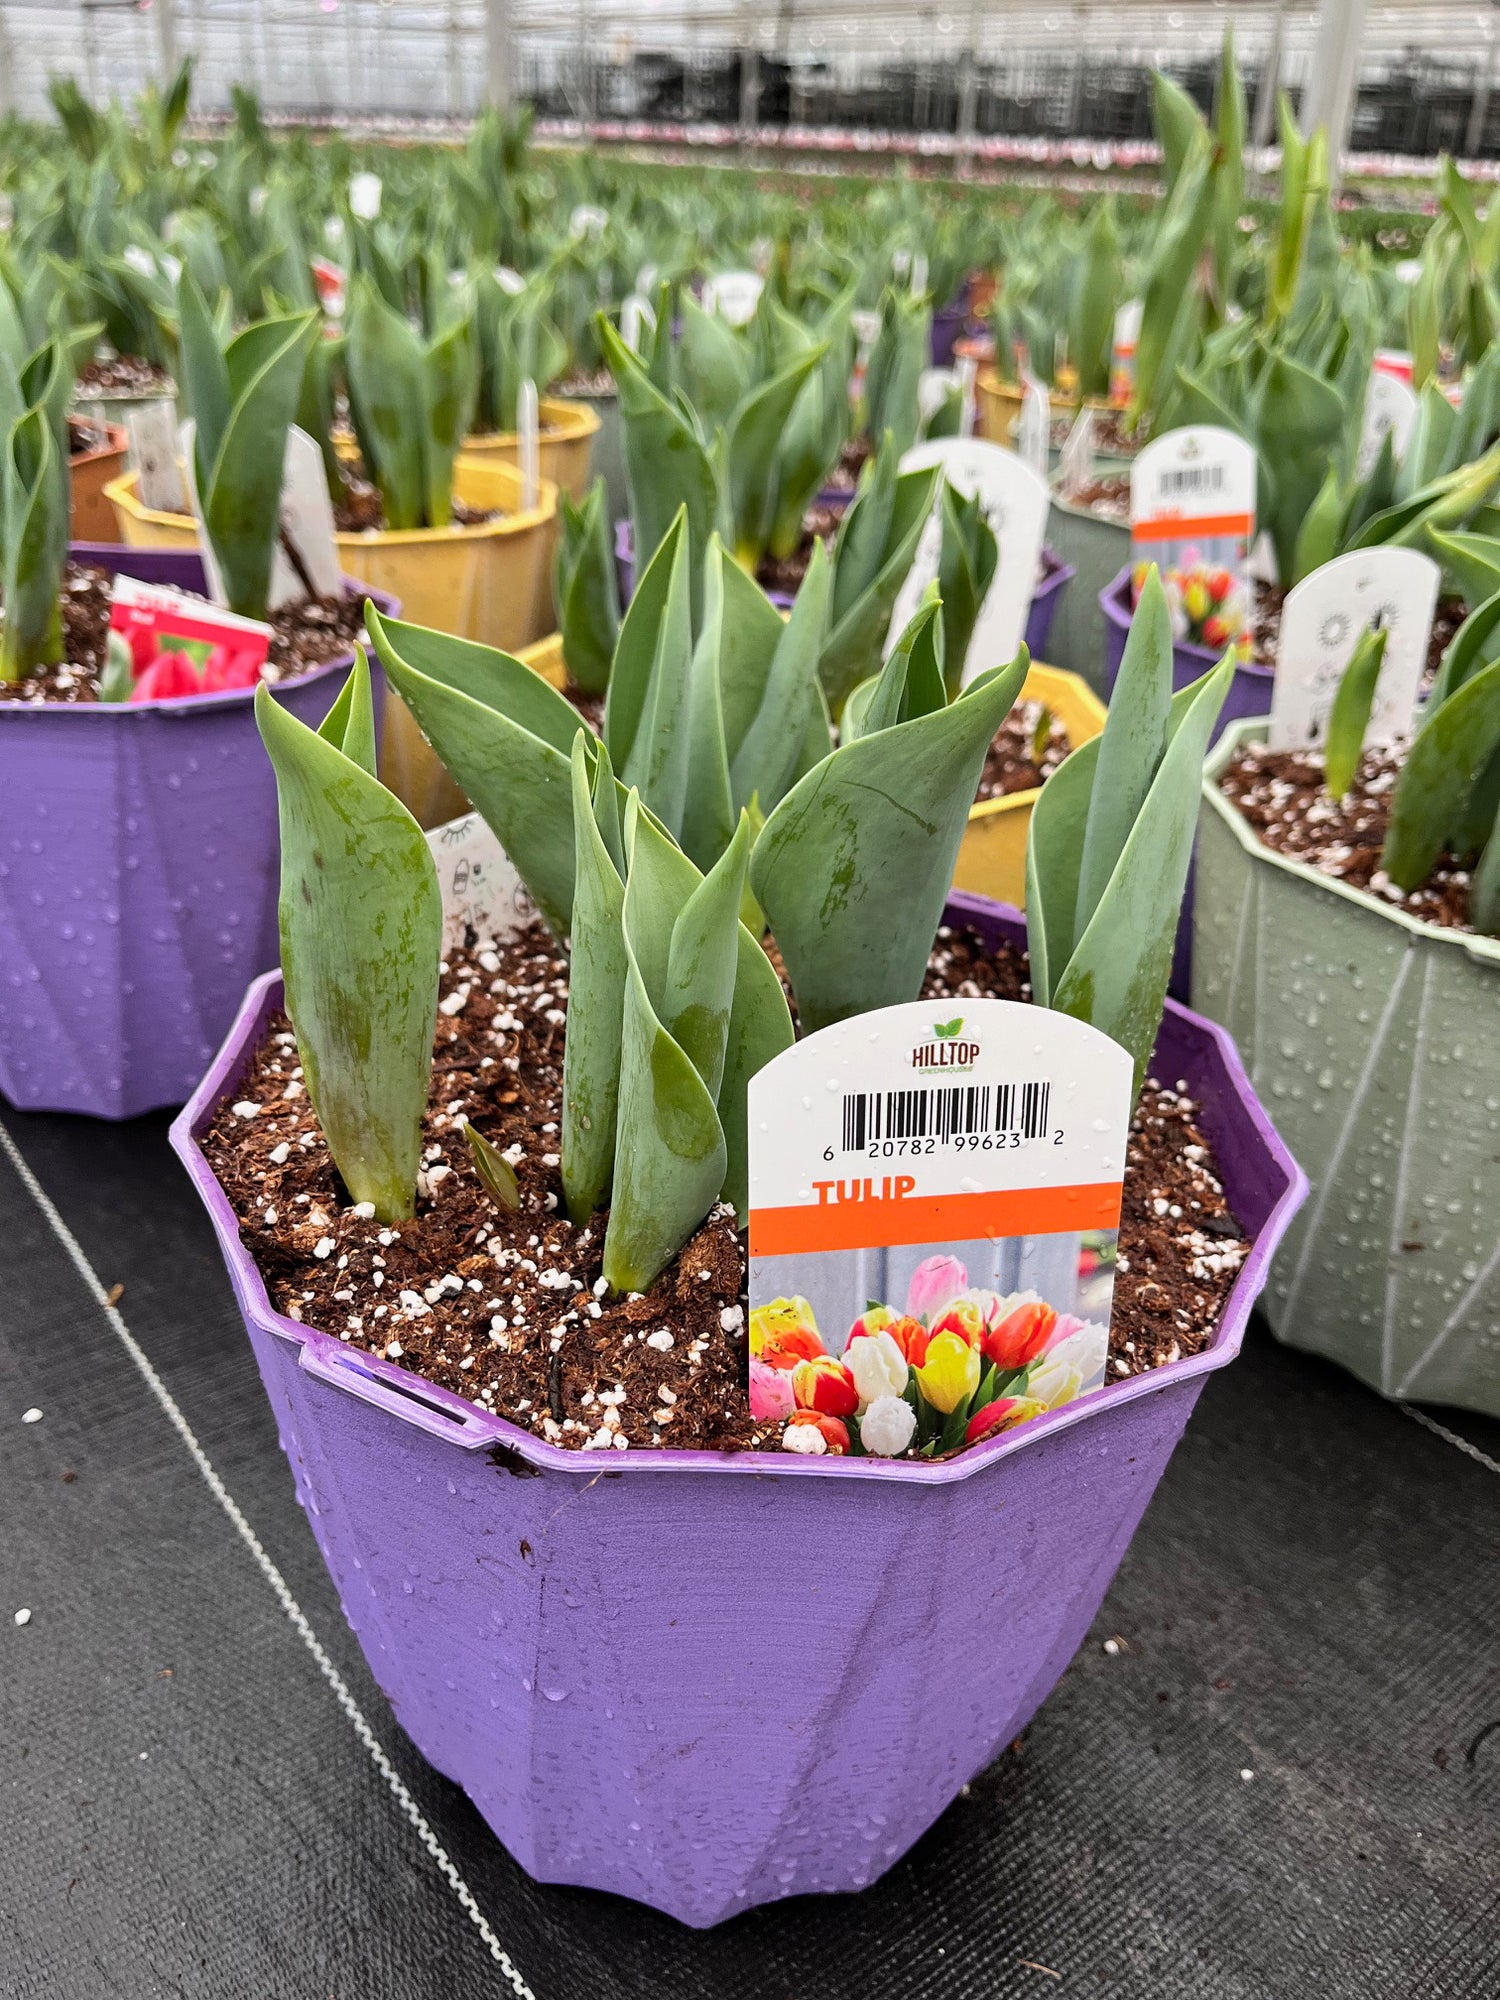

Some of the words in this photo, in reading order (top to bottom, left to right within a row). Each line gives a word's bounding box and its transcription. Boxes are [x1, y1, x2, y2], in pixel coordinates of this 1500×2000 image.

[912, 1042, 980, 1068] HILLTOP
[823, 1145, 835, 1161] 6
[868, 1139, 936, 1158] 20782
[954, 1133, 1021, 1152] 99623
[1053, 1129, 1065, 1145] 2
[812, 1175, 916, 1205] TULIP
